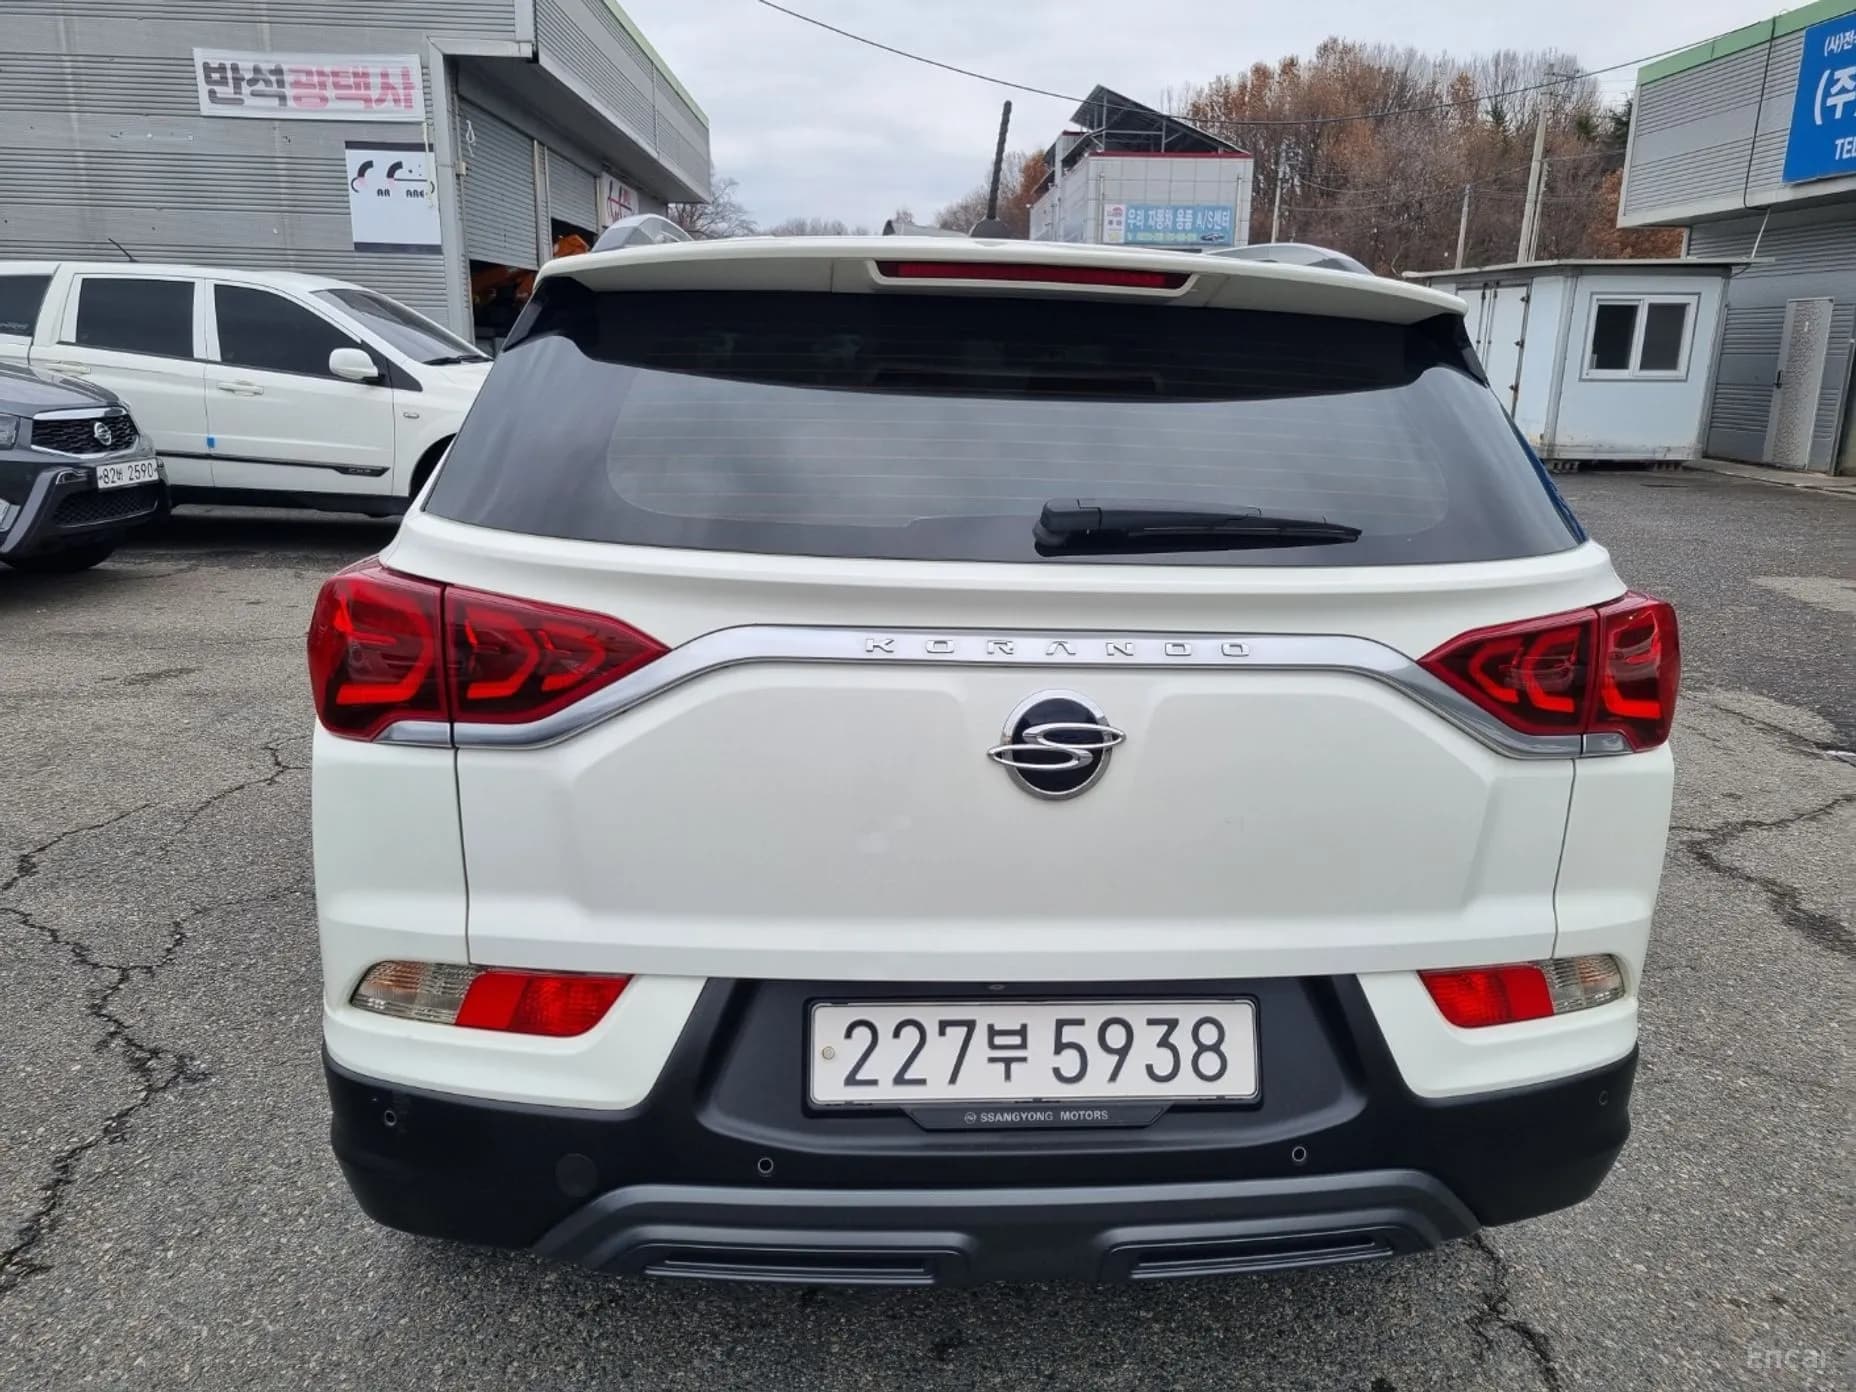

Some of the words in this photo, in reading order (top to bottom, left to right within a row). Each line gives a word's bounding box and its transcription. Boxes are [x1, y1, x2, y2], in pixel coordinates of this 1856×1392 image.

[1824, 29, 1856, 57] (사)전
[202, 61, 415, 109] 반석광택사
[1814, 66, 1856, 125] (주
[1127, 208, 1145, 230] 우리
[1148, 208, 1173, 230] 자동차
[1176, 208, 1194, 230] 용품
[127, 462, 154, 481] 2590
[865, 638, 1250, 657] KORANDO
[843, 1018, 1029, 1087] 227부
[1052, 1016, 1228, 1085] 5938
[980, 1111, 1053, 1123] SSANGYONG
[1060, 1109, 1109, 1121] MOTORS
